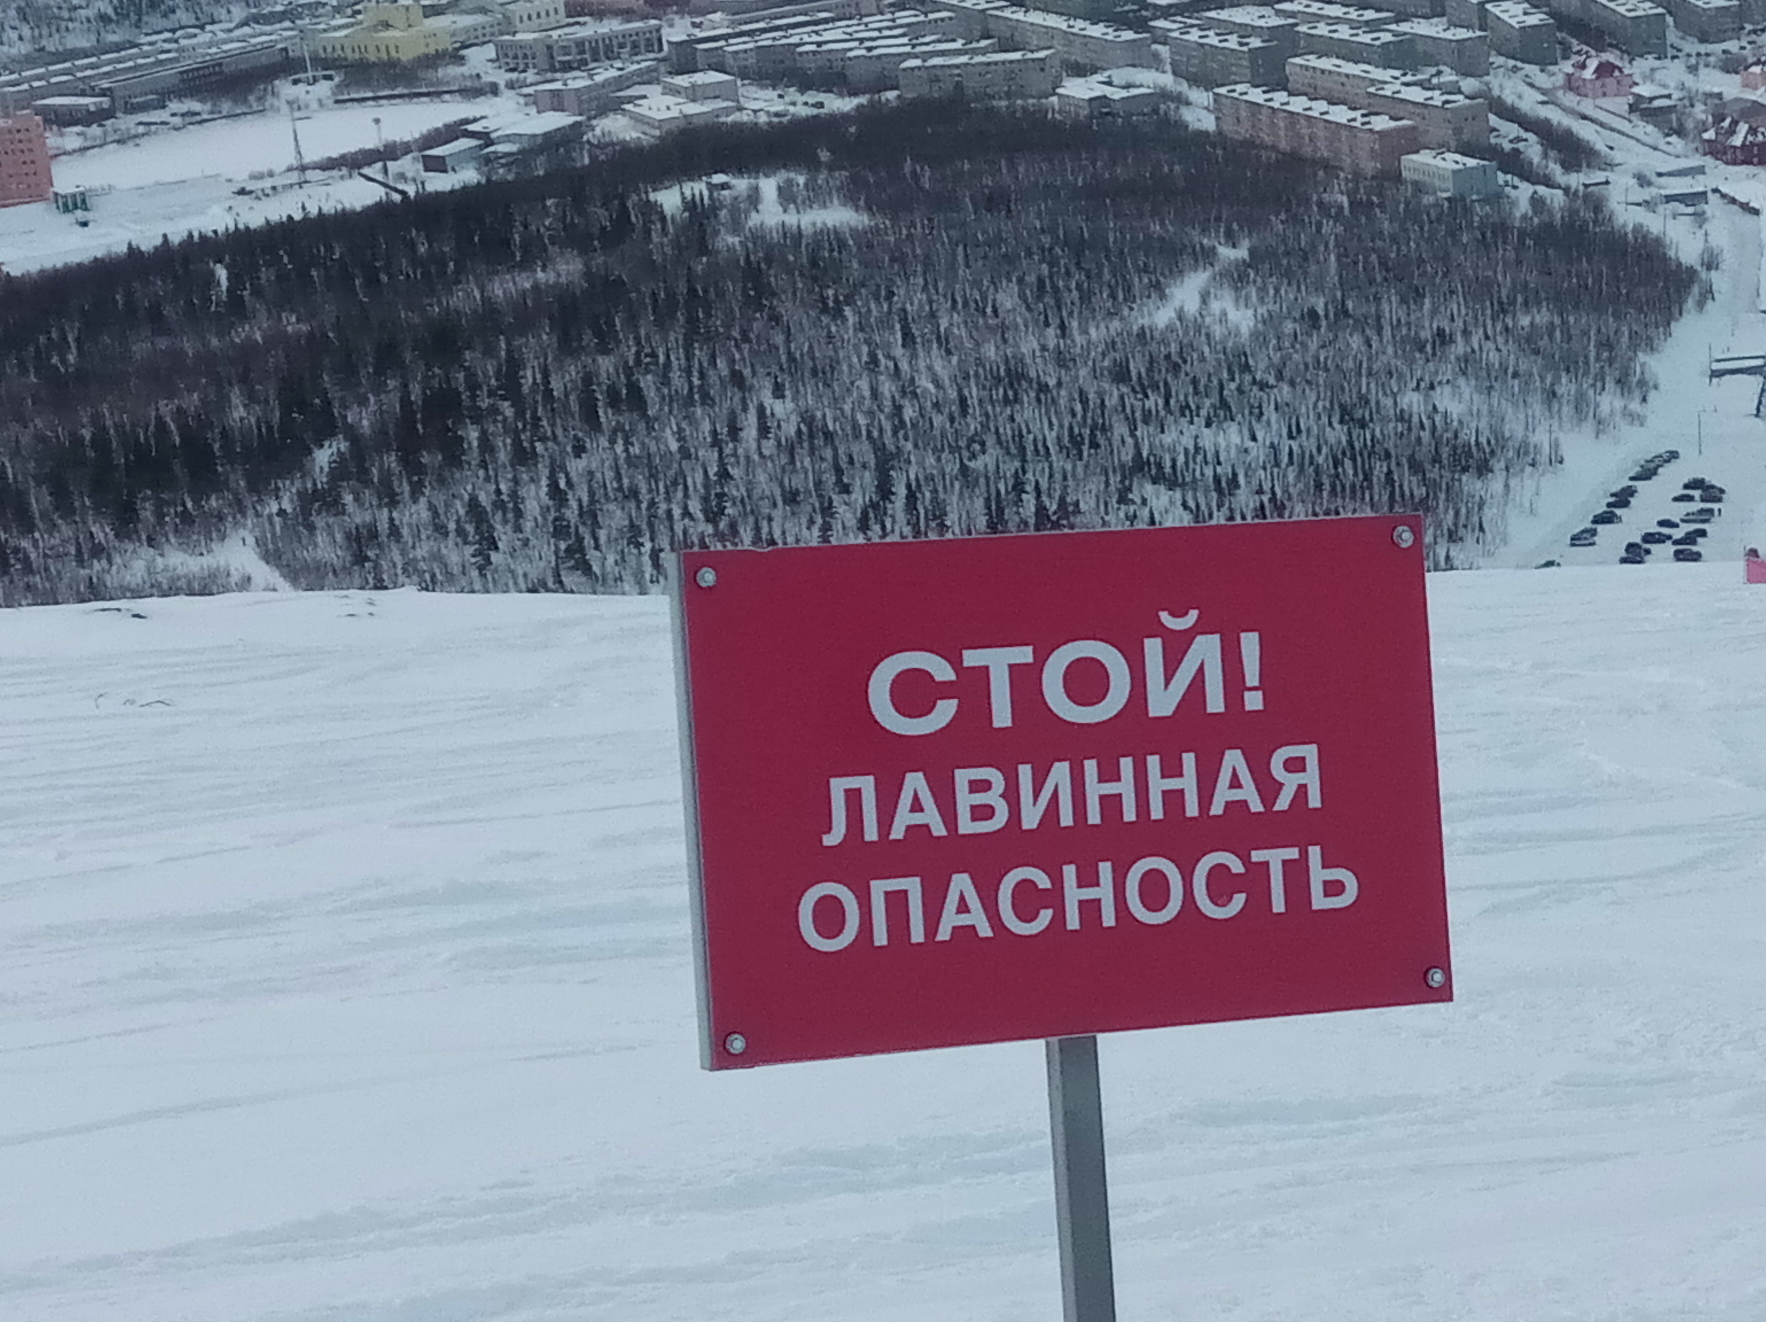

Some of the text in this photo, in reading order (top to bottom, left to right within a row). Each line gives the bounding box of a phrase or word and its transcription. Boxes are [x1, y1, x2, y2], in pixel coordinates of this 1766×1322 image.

[867, 608, 1264, 736] СТОЙ!
[822, 743, 1323, 847] ЛАВИННАЯ
[797, 844, 1359, 952] ОПАСНОСТЬ
